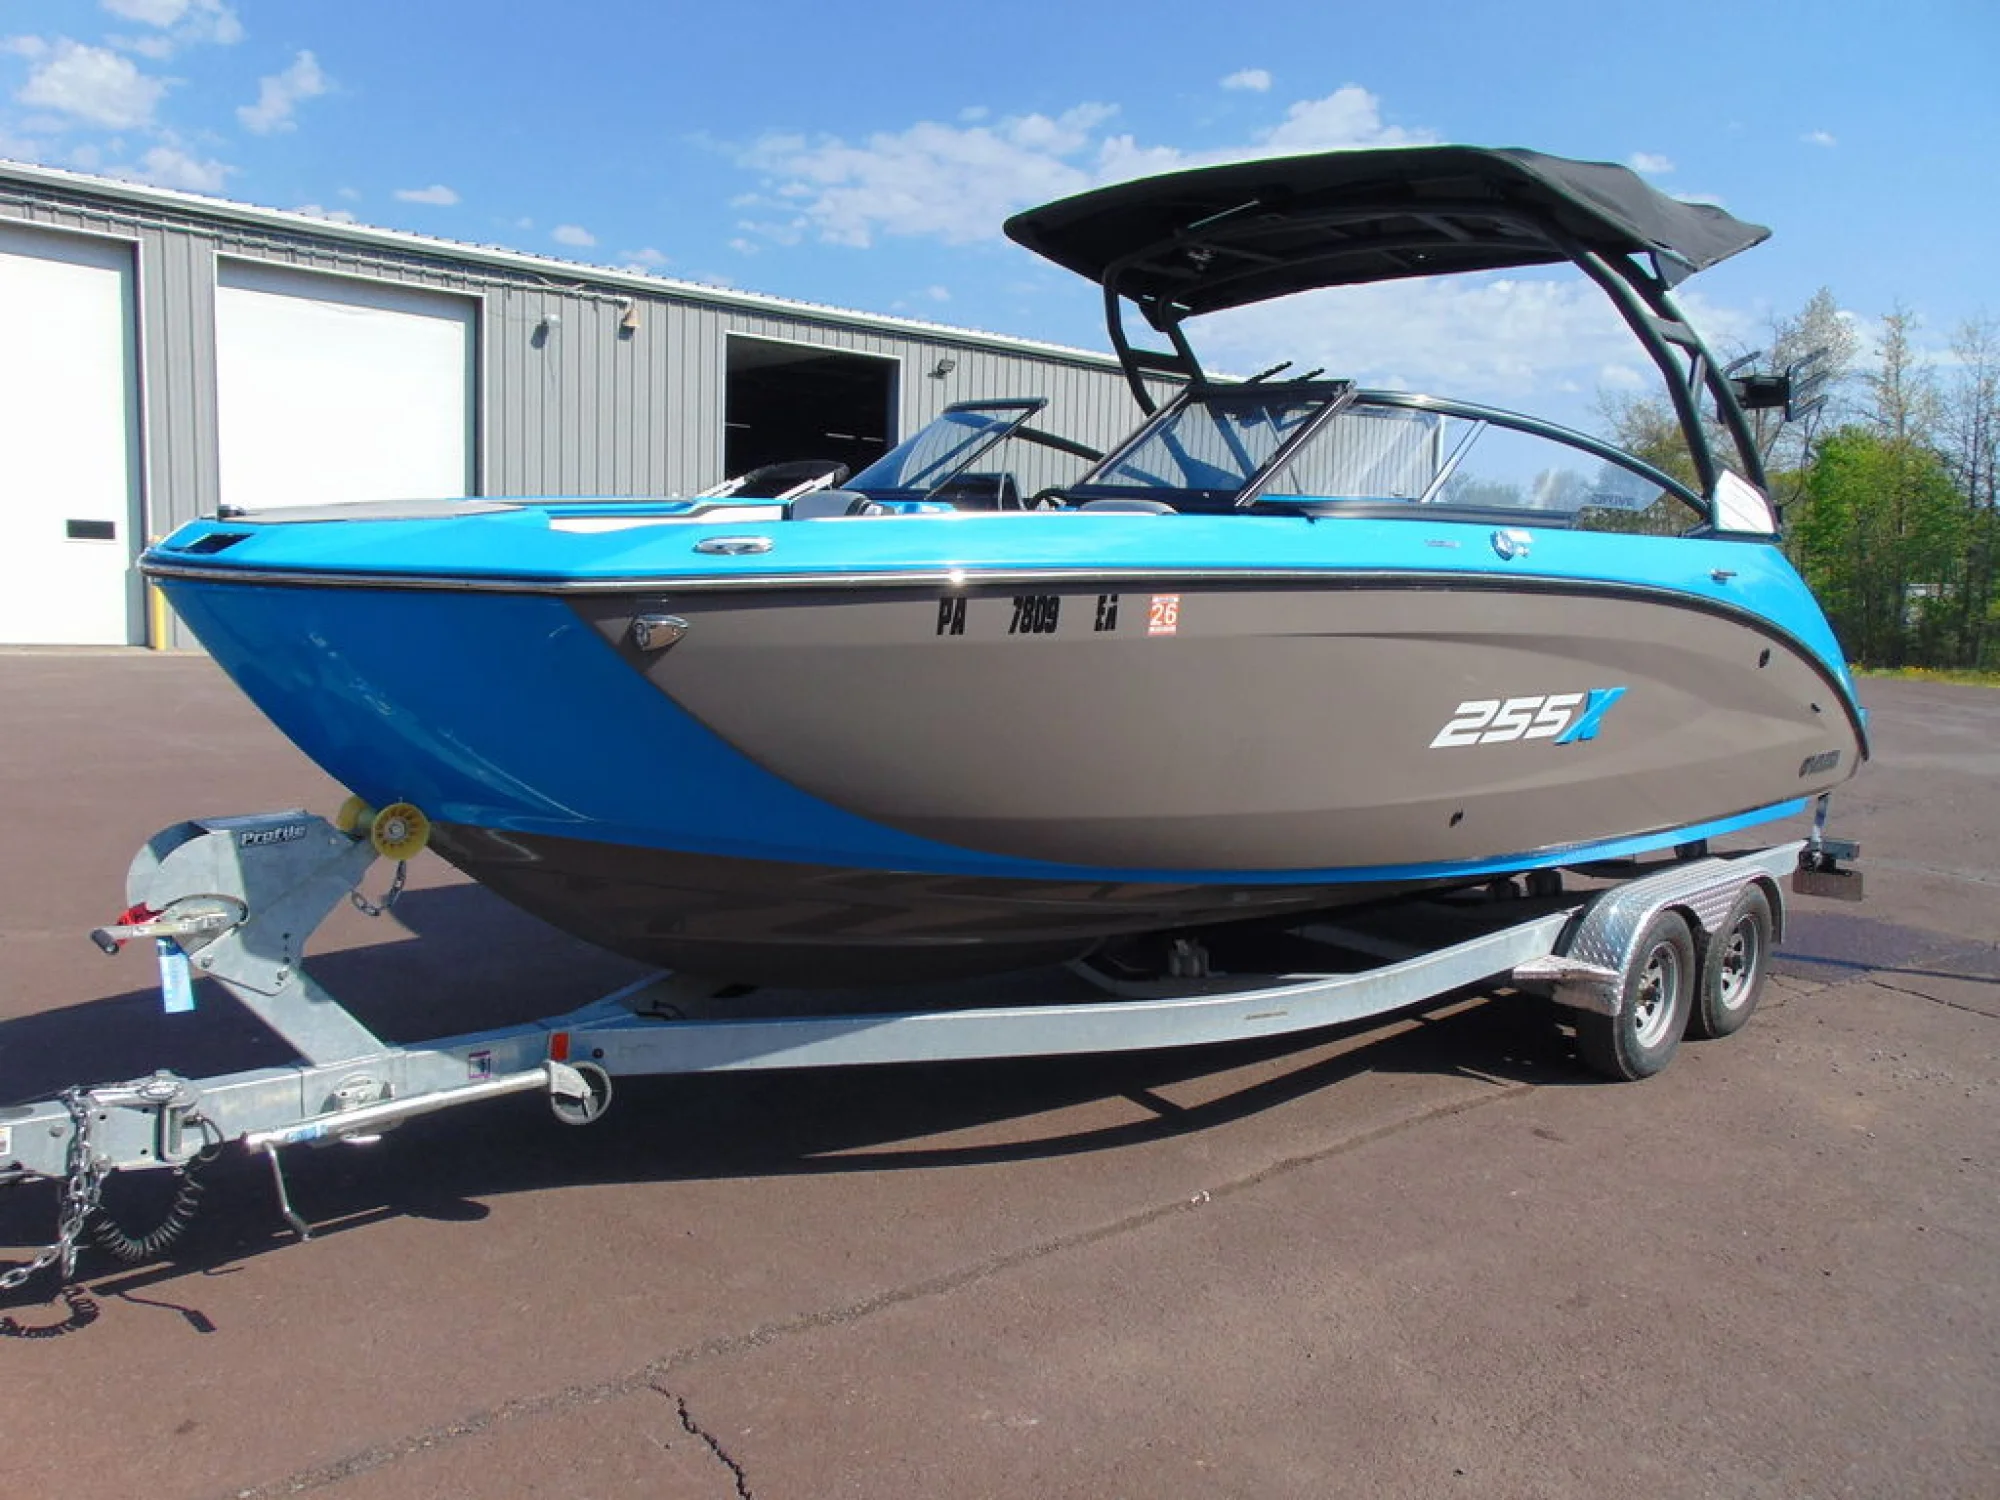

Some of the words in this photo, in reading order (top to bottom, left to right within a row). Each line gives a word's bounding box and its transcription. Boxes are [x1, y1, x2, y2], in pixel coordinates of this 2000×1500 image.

[937, 597, 967, 635] PA
[1008, 596, 1059, 635] 7809
[1149, 602, 1178, 626] 26
[1429, 687, 1627, 748] 255X
